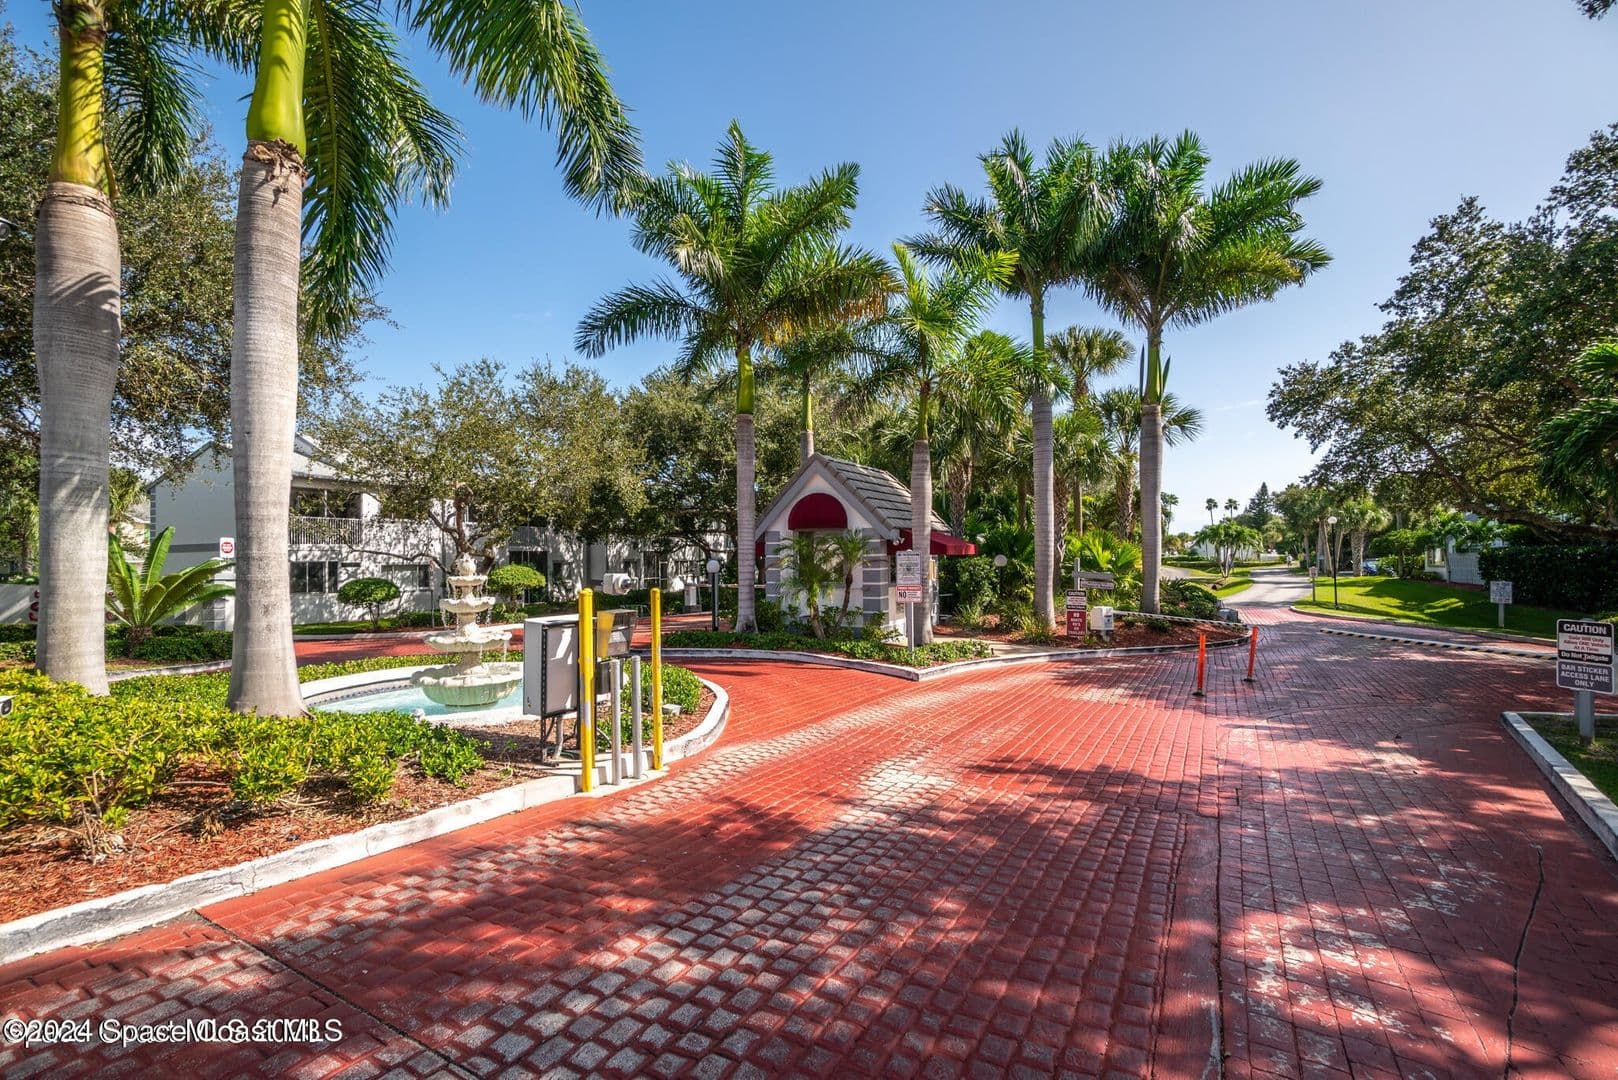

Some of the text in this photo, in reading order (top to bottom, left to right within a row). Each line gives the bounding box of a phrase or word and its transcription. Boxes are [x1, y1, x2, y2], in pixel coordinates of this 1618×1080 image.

[899, 591, 907, 599] NO
[1563, 624, 1606, 635] CAUTION
[1577, 666, 1609, 675] STICKER
[1561, 670, 1609, 683] ACCESS LANE
